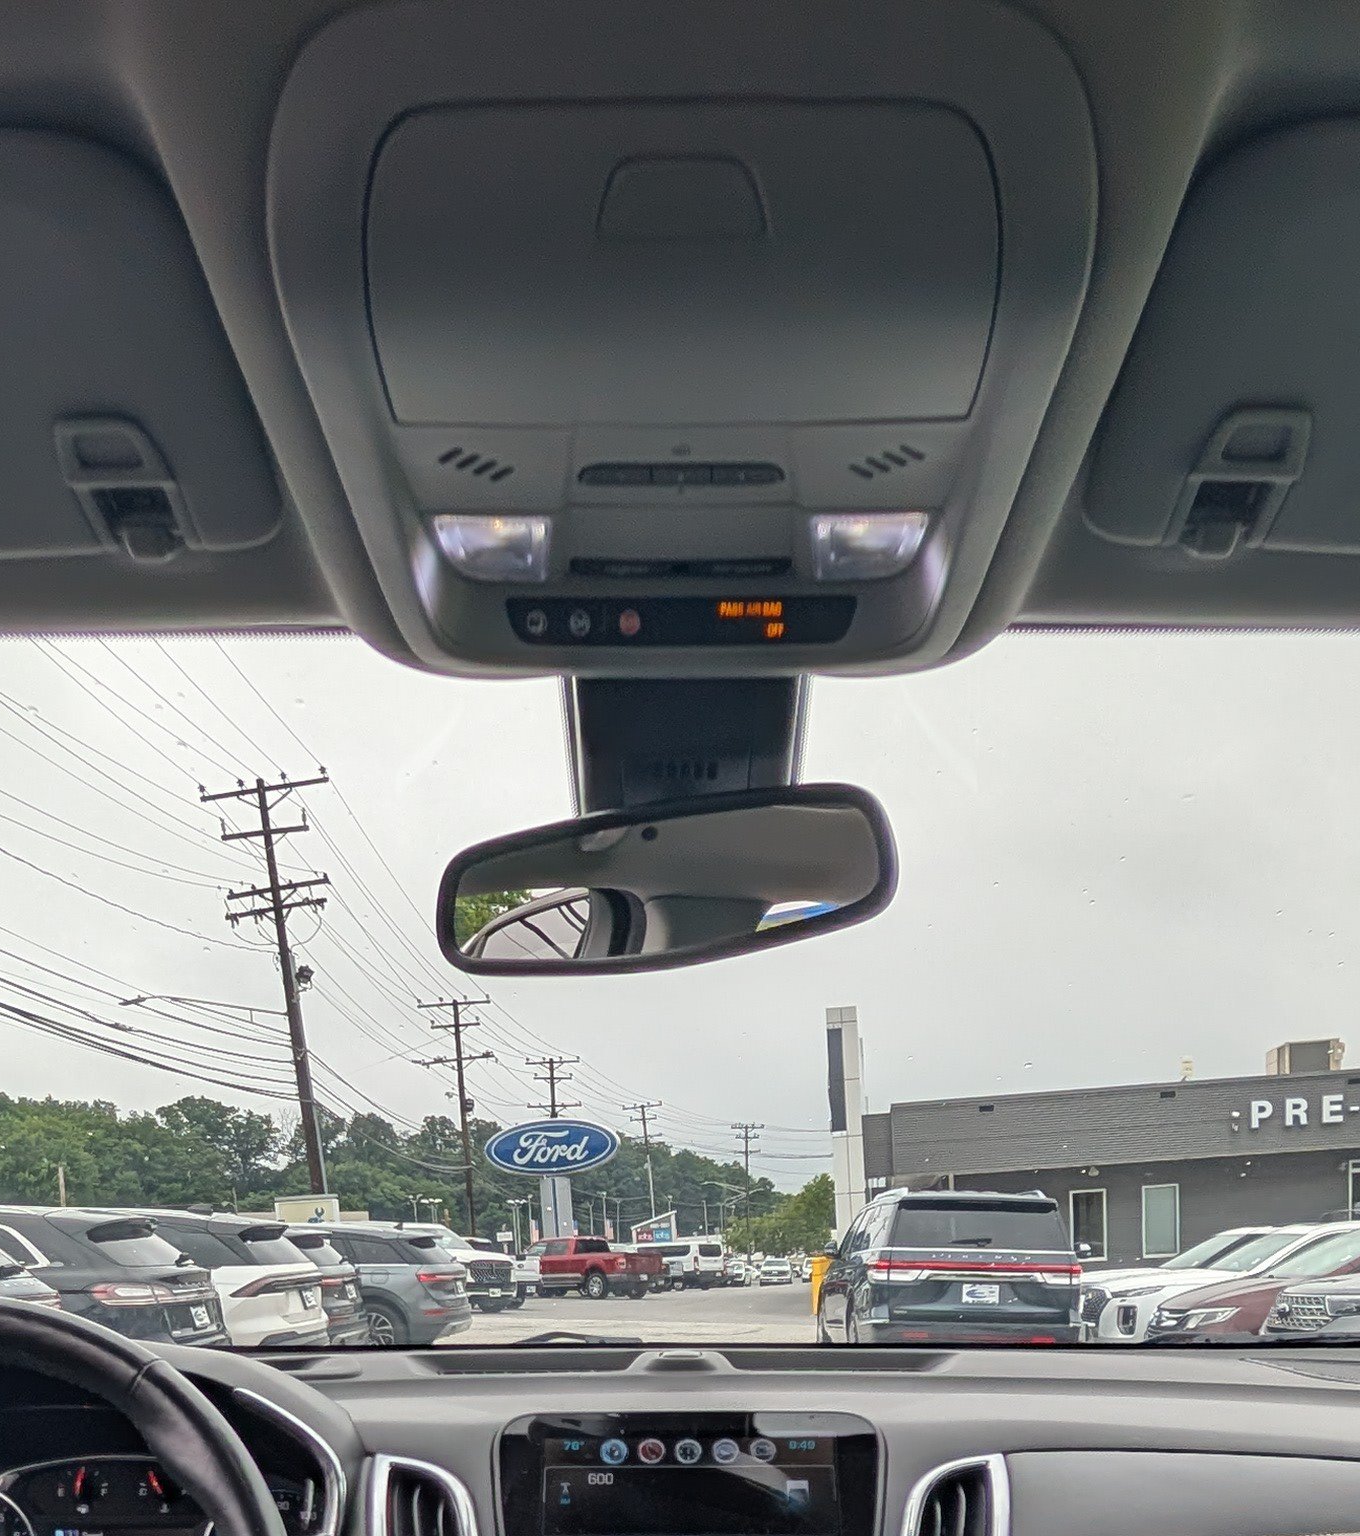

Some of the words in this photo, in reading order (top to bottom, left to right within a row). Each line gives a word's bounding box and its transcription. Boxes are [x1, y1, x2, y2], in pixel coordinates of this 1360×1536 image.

[719, 601, 744, 617] PASS
[762, 601, 782, 617] BAG
[766, 622, 785, 638] OFF
[512, 1129, 590, 1166] Ford
[587, 1472, 615, 1486] 600
